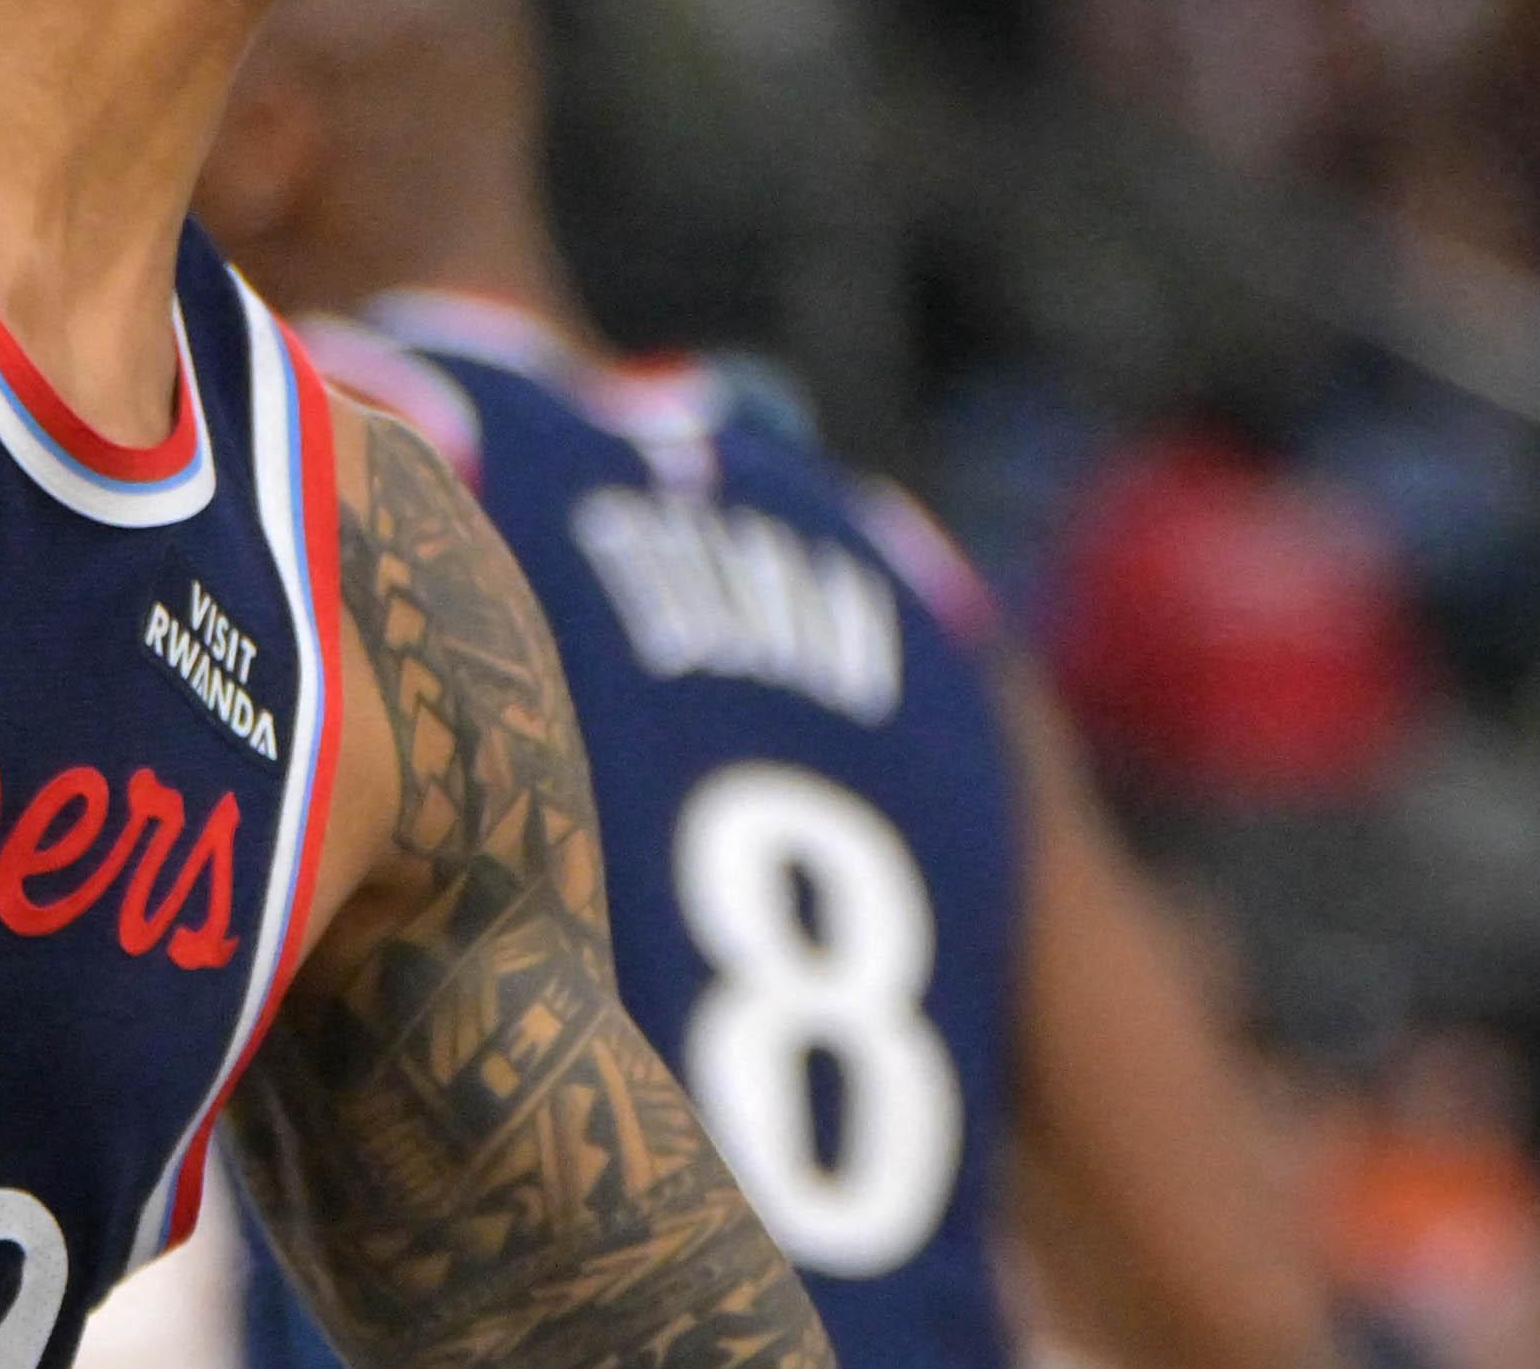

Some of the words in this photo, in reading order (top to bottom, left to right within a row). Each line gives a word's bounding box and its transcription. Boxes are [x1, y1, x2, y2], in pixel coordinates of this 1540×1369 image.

[145, 601, 278, 761] RWANDA
[191, 580, 257, 684] VISIT
[671, 759, 966, 1279] 8
